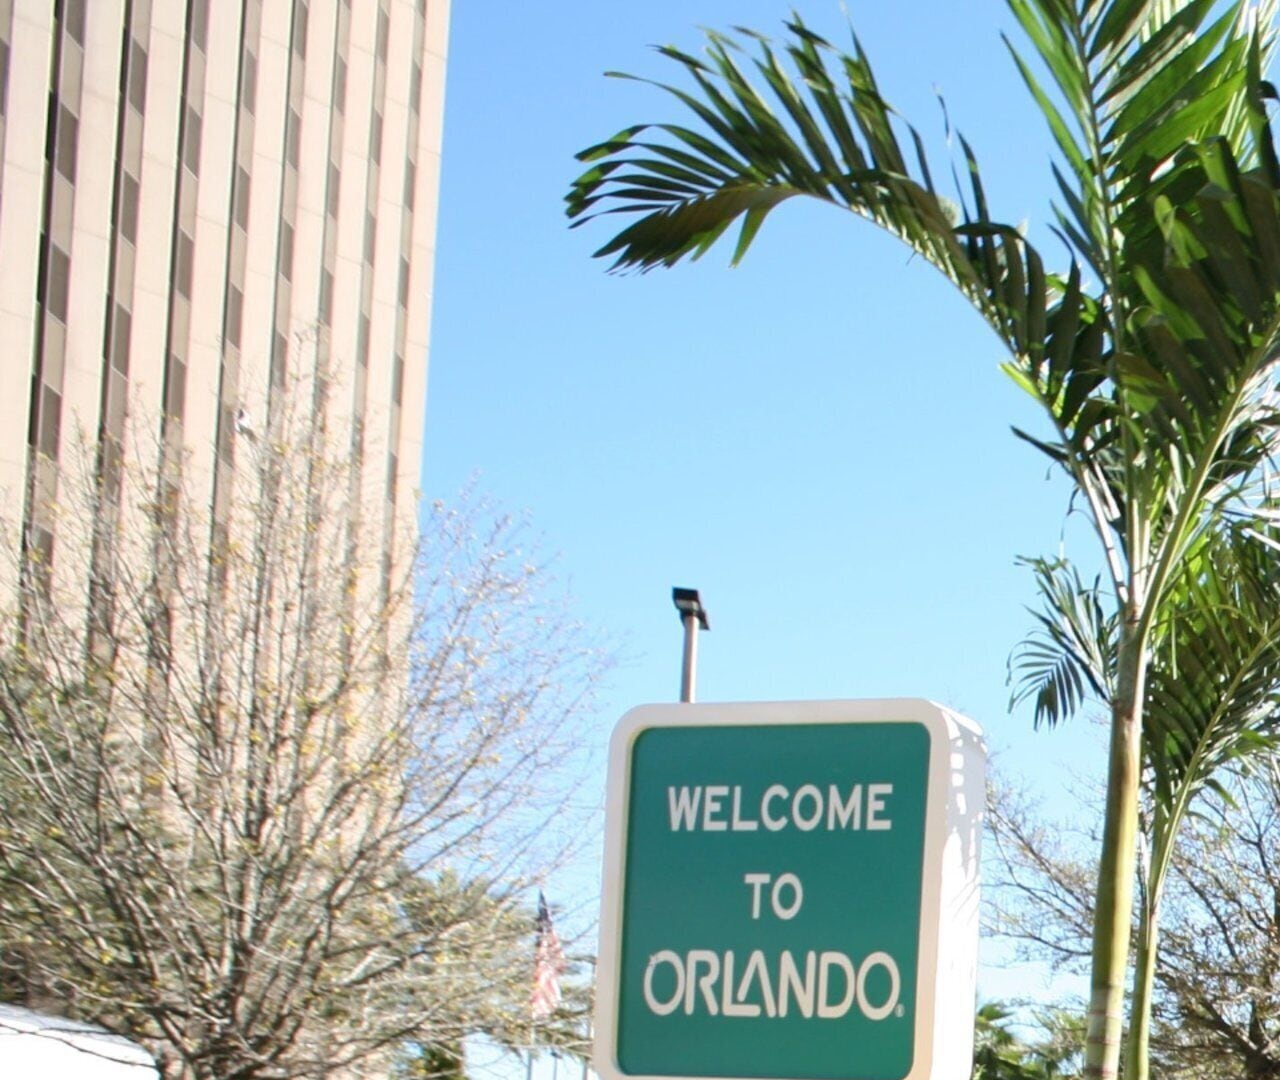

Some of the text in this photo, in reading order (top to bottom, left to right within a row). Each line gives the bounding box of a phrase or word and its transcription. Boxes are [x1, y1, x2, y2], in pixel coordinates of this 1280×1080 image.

[667, 783, 893, 832] WELCOME
[744, 872, 804, 921] TO
[643, 949, 902, 1021] ORLANDO
